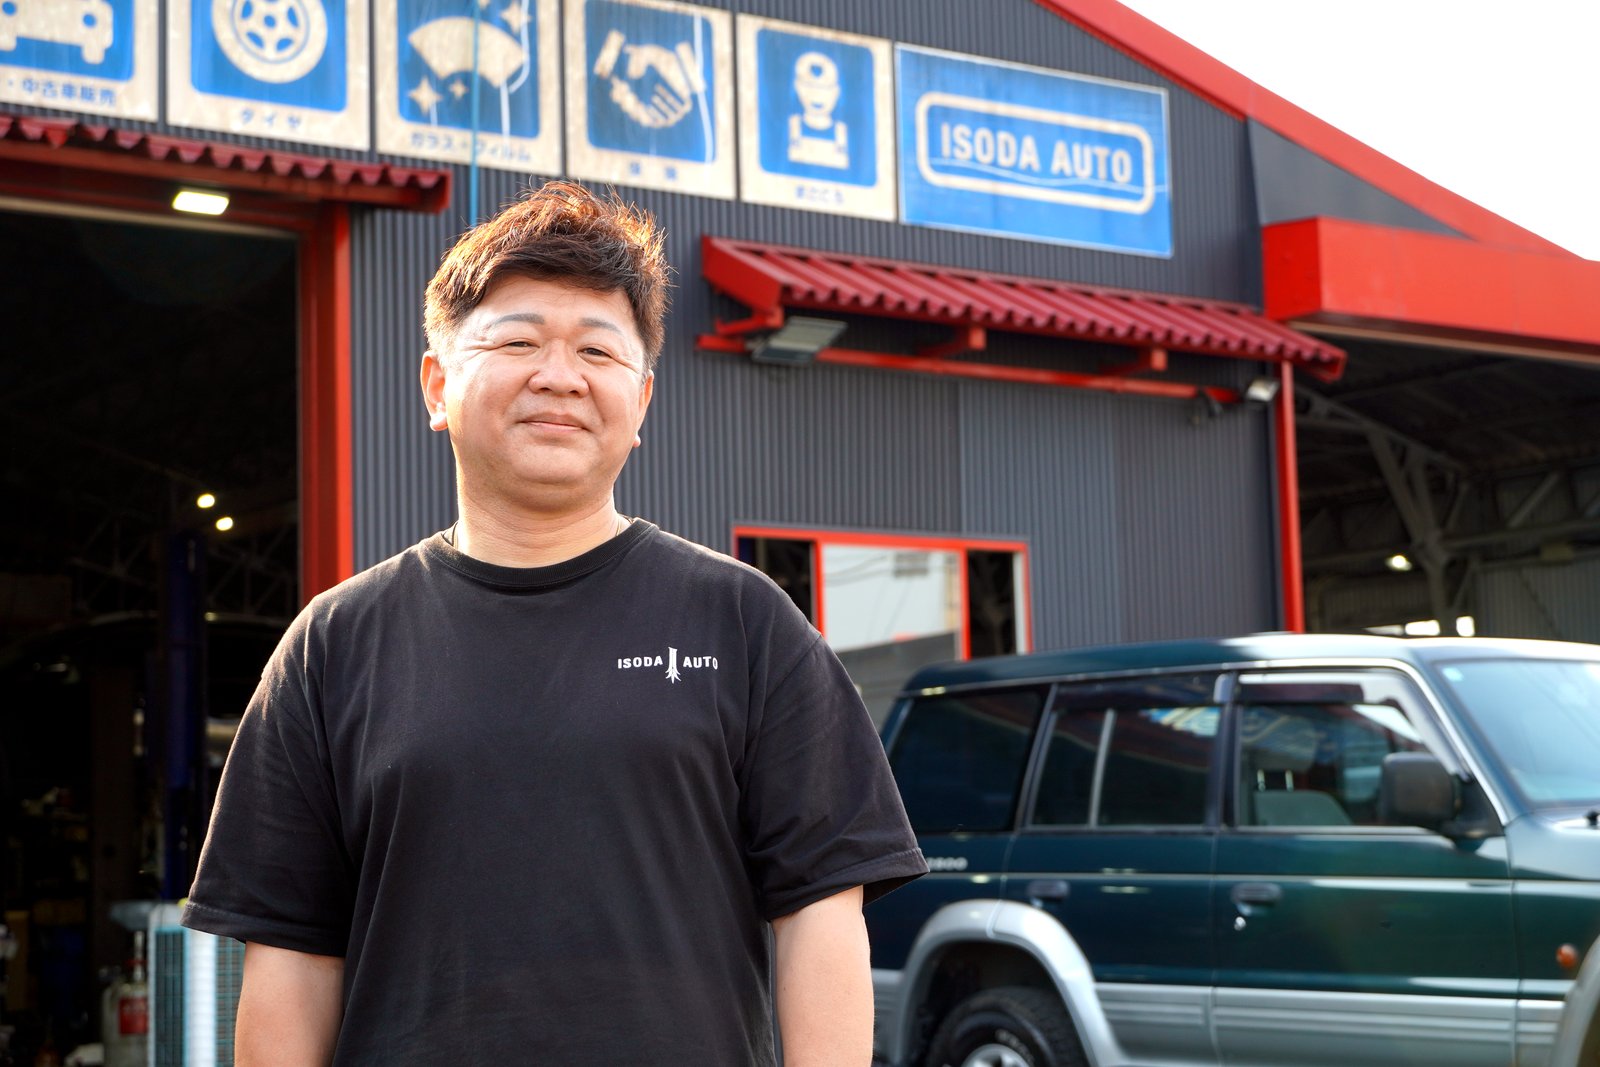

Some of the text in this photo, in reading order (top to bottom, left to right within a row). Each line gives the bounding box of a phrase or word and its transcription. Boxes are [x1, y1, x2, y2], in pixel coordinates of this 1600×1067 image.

[941, 122, 1133, 184] ISODA AUTO
[617, 655, 719, 670] ISODA AUTO
